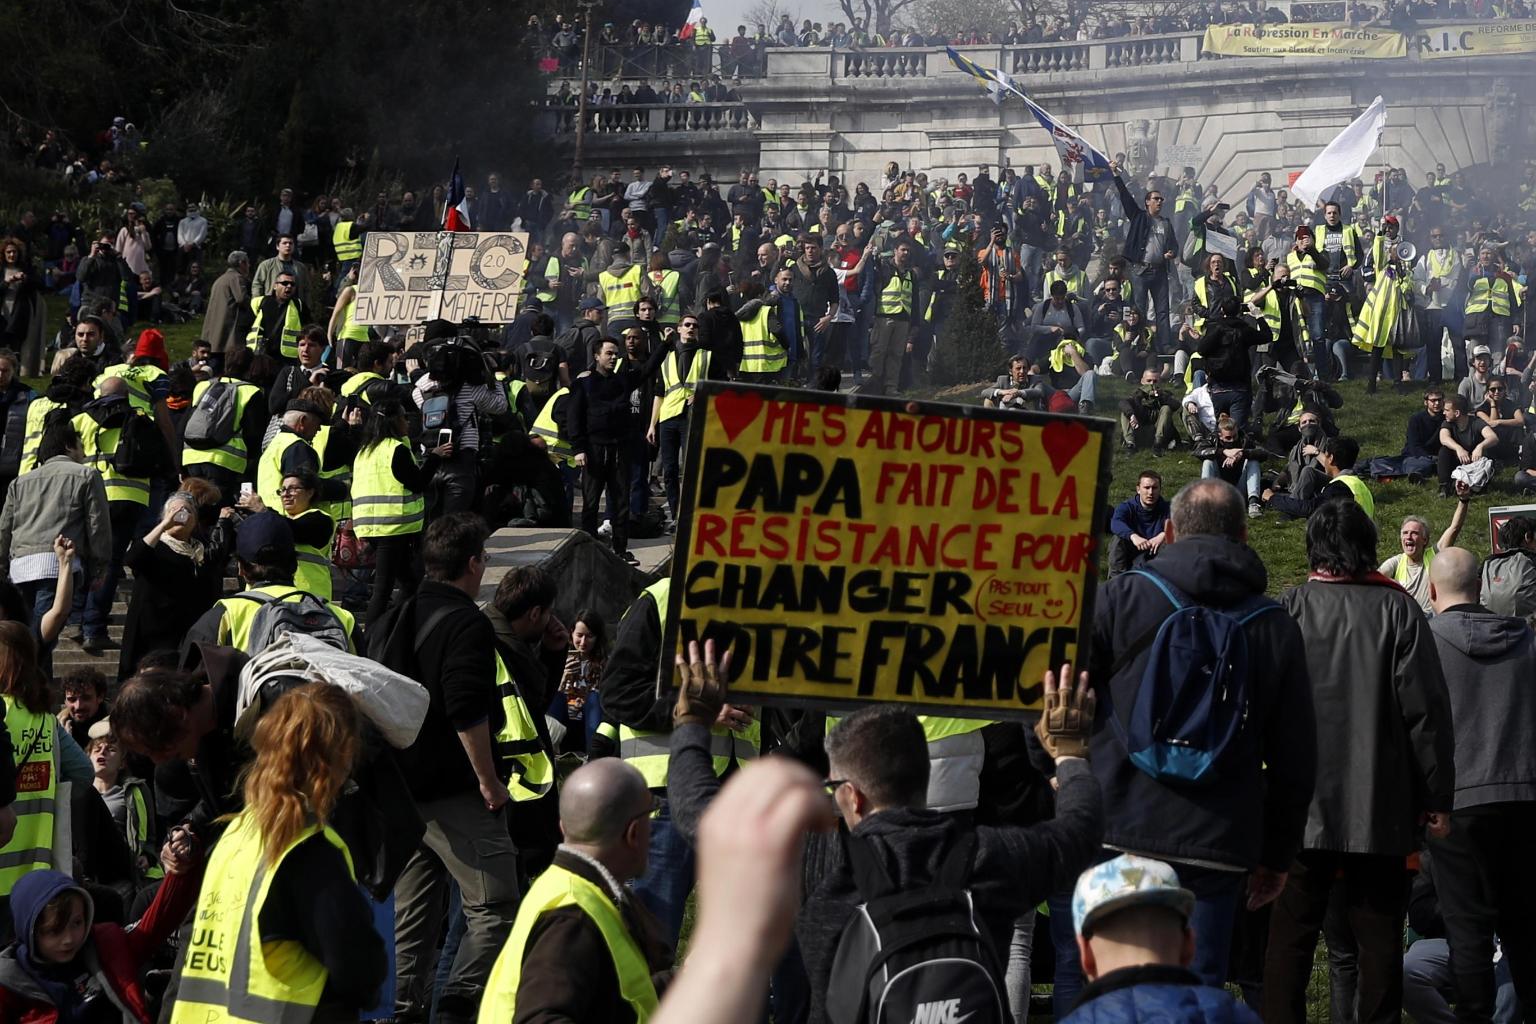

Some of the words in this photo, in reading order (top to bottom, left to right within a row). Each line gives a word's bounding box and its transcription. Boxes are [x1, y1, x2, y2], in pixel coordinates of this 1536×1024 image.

[1312, 28, 1329, 39] En
[1332, 29, 1378, 40] Marche
[1525, 23, 1536, 32] DE
[483, 254, 506, 268] 2.0
[355, 296, 380, 321] EN
[384, 294, 431, 321] TOUTE
[761, 399, 847, 446] MES
[856, 410, 1024, 462] AMOURS
[699, 447, 862, 519] PAPA
[875, 462, 968, 506] FAIT
[971, 467, 1021, 514] DE
[1029, 471, 1079, 520] LA
[1011, 532, 1097, 574] POUR
[684, 561, 976, 616] CHANGER
[1015, 581, 1050, 595] TOUT
[988, 600, 1038, 617] SEUL
[915, 998, 960, 1024] NIKE
